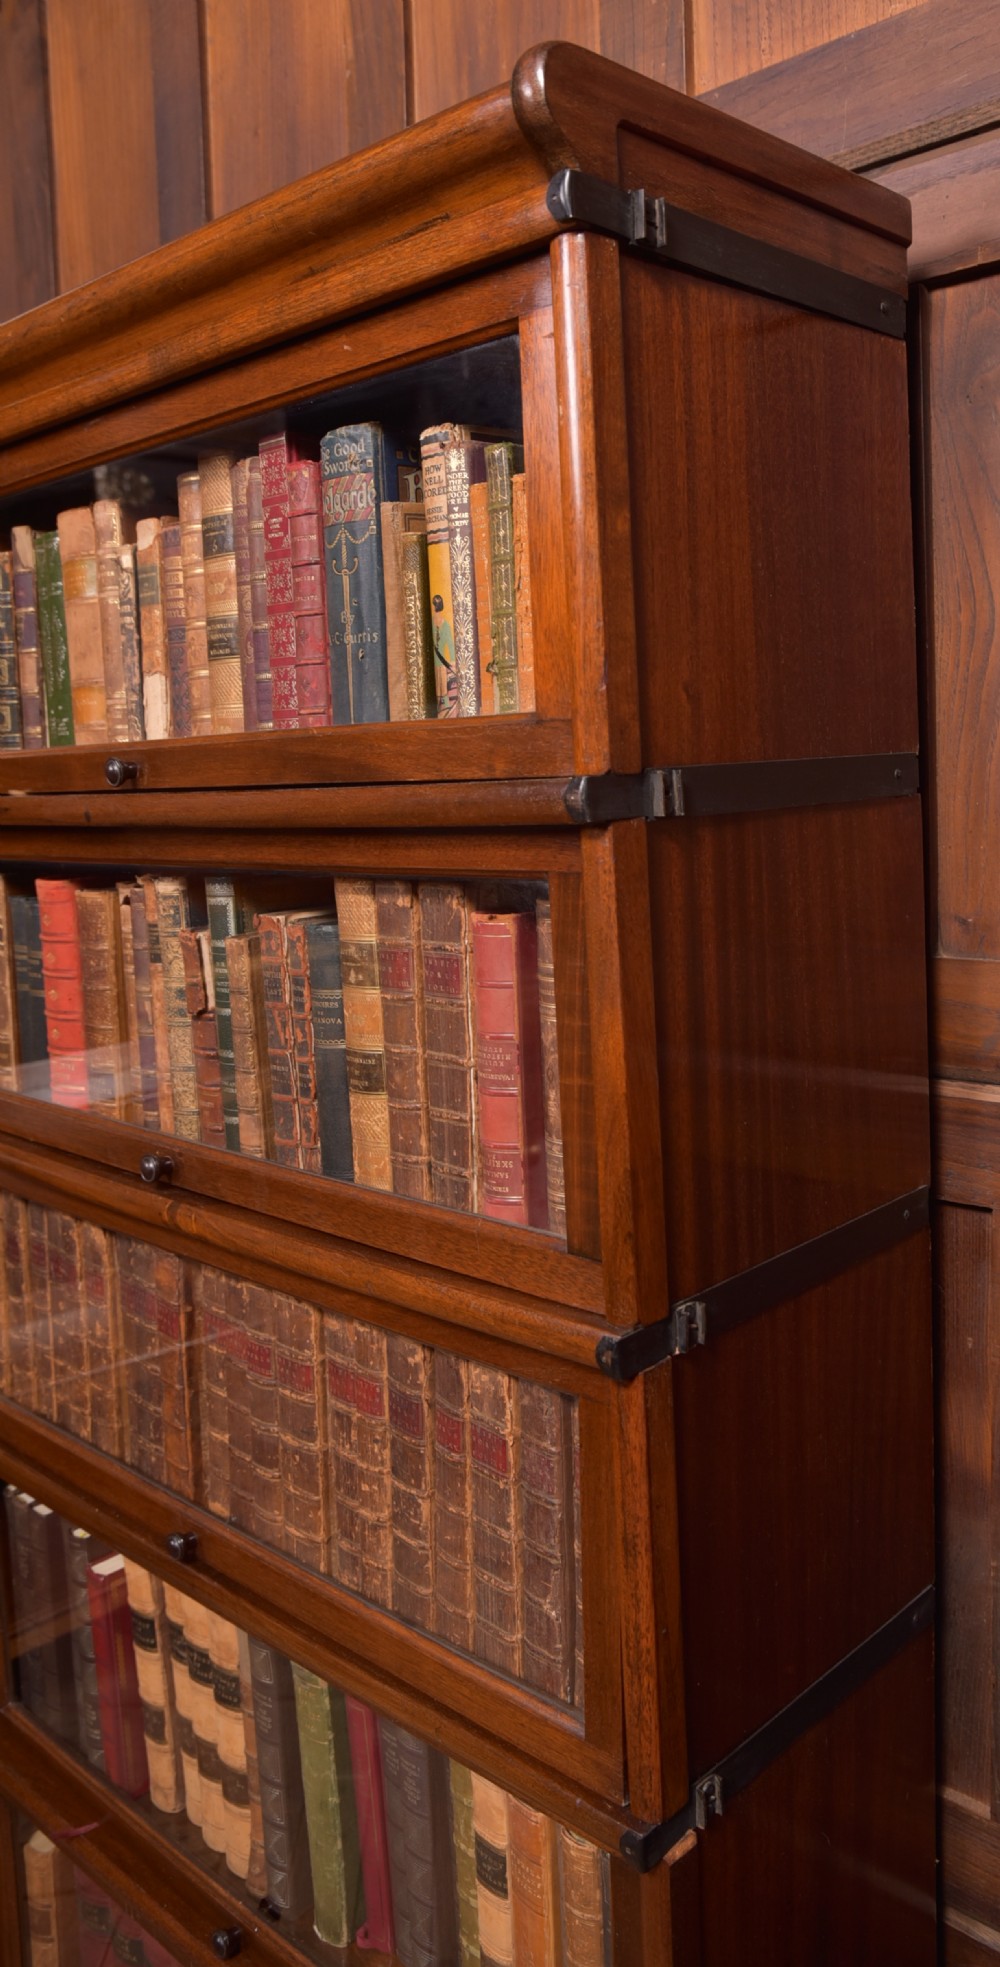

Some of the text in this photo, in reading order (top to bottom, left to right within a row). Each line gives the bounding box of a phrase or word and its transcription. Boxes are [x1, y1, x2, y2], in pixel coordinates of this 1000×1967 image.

[333, 437, 365, 457] Good
[424, 463, 443, 476] HOW
[446, 472, 469, 480] NDER
[424, 475, 444, 487] NELL
[447, 484, 469, 492] REEN
[323, 479, 377, 523] elgarde
[340, 610, 356, 626] By
